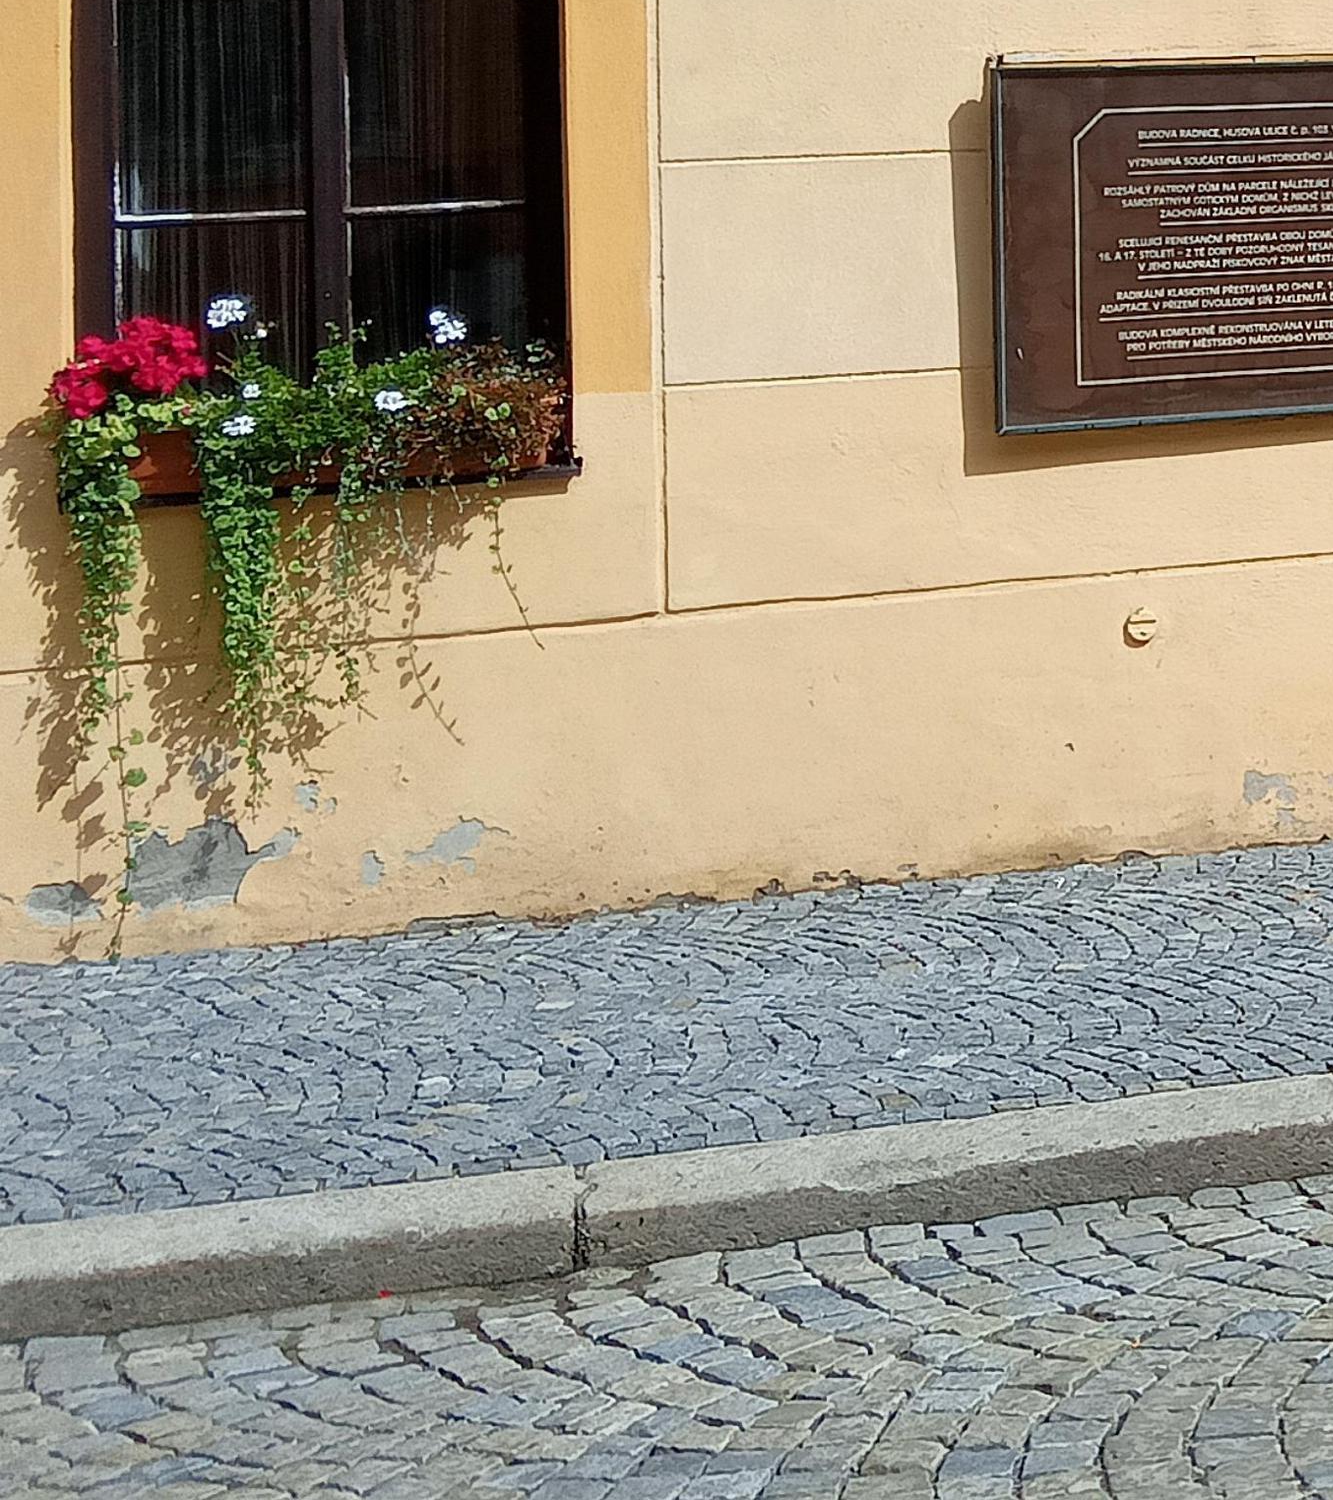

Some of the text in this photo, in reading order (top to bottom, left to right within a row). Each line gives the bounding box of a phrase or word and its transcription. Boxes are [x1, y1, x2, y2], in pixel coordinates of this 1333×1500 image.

[1138, 130, 1177, 139] BUDOVA
[1223, 128, 1260, 136] HUSOVA
[1263, 126, 1288, 135] ULICE
[1226, 155, 1255, 164] CELKU
[1238, 181, 1277, 190] PARCELE
[1259, 204, 1317, 214] ORGANISMUS
[1280, 231, 1305, 240] OBOU
[1207, 247, 1233, 256] DOBY
[1148, 261, 1171, 271] JEHO
[1280, 256, 1304, 264] ZNAK
[1291, 282, 1314, 290] OHNI
[1118, 330, 1158, 340] BUDOVA
[1126, 343, 1146, 351] PRO
